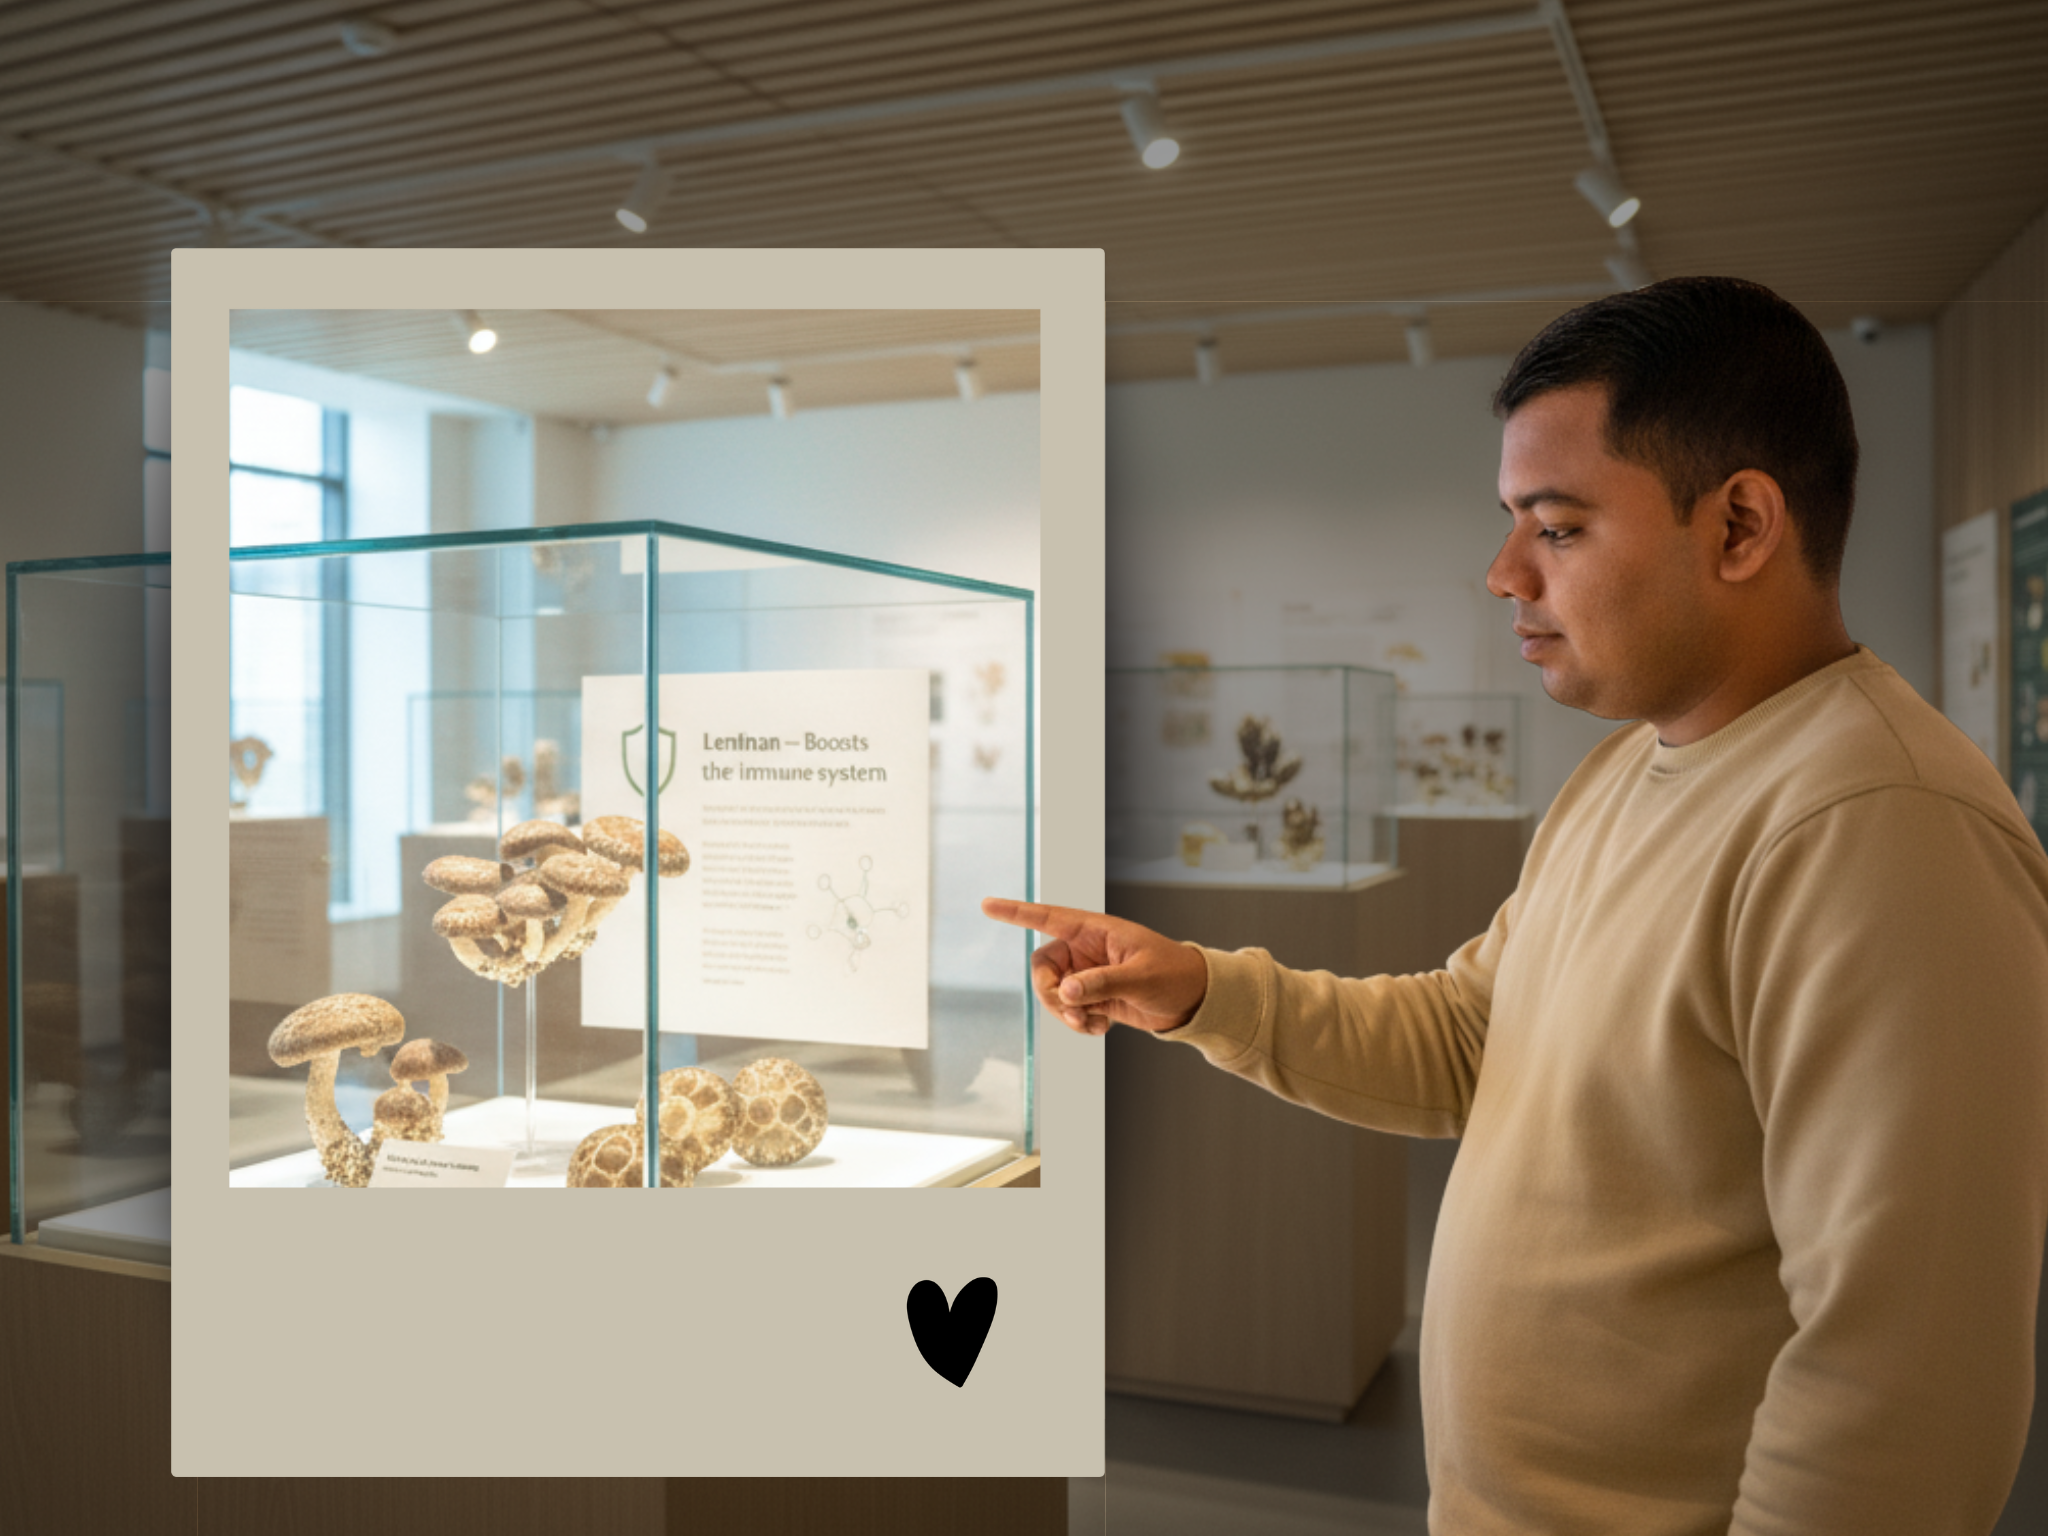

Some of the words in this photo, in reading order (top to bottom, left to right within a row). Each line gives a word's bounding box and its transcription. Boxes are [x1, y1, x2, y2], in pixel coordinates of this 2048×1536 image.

[804, 732, 869, 752] Boosts
[702, 761, 734, 781] the
[817, 765, 887, 788] system
